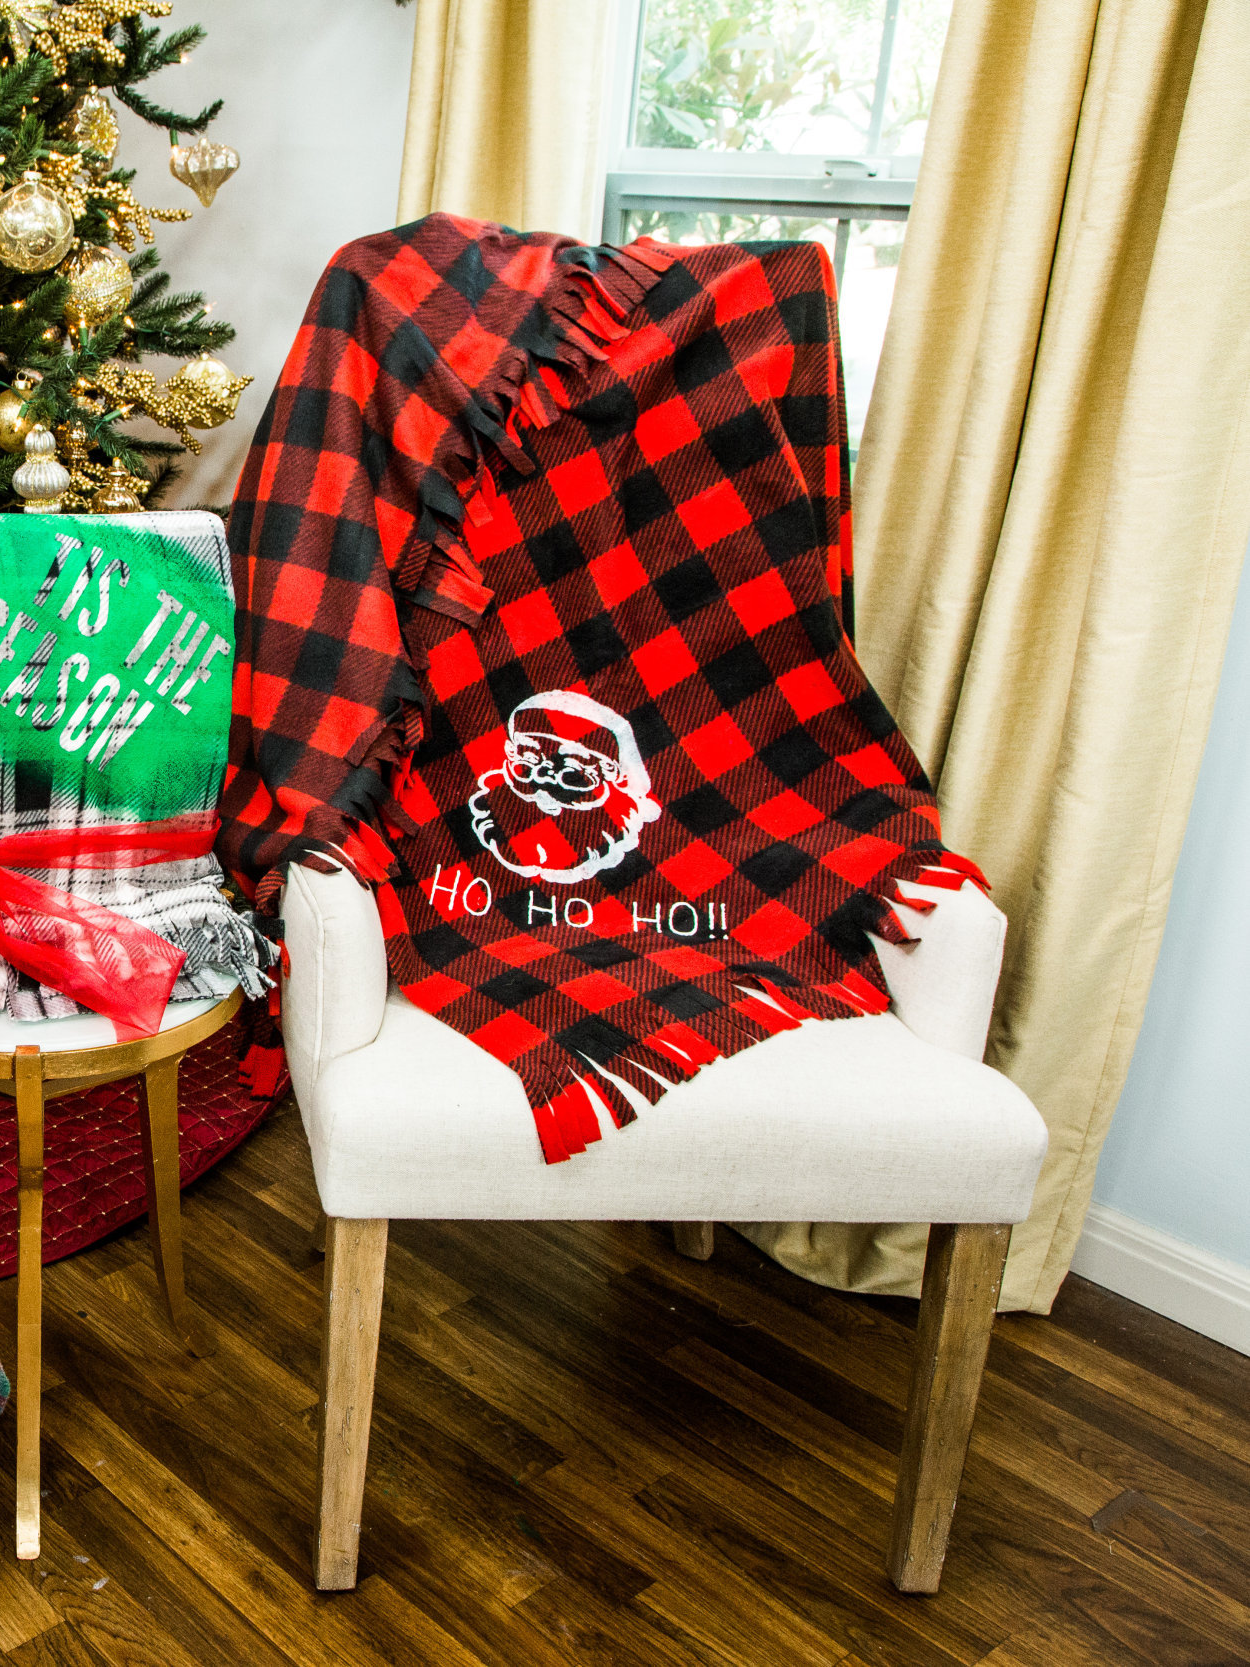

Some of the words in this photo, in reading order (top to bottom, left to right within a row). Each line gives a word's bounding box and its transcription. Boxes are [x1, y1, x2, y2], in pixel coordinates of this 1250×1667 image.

[33, 533, 130, 637] TIS
[123, 589, 231, 715] THE
[429, 864, 492, 916] HO
[527, 890, 593, 928] HO
[633, 902, 729, 940] HO!!
